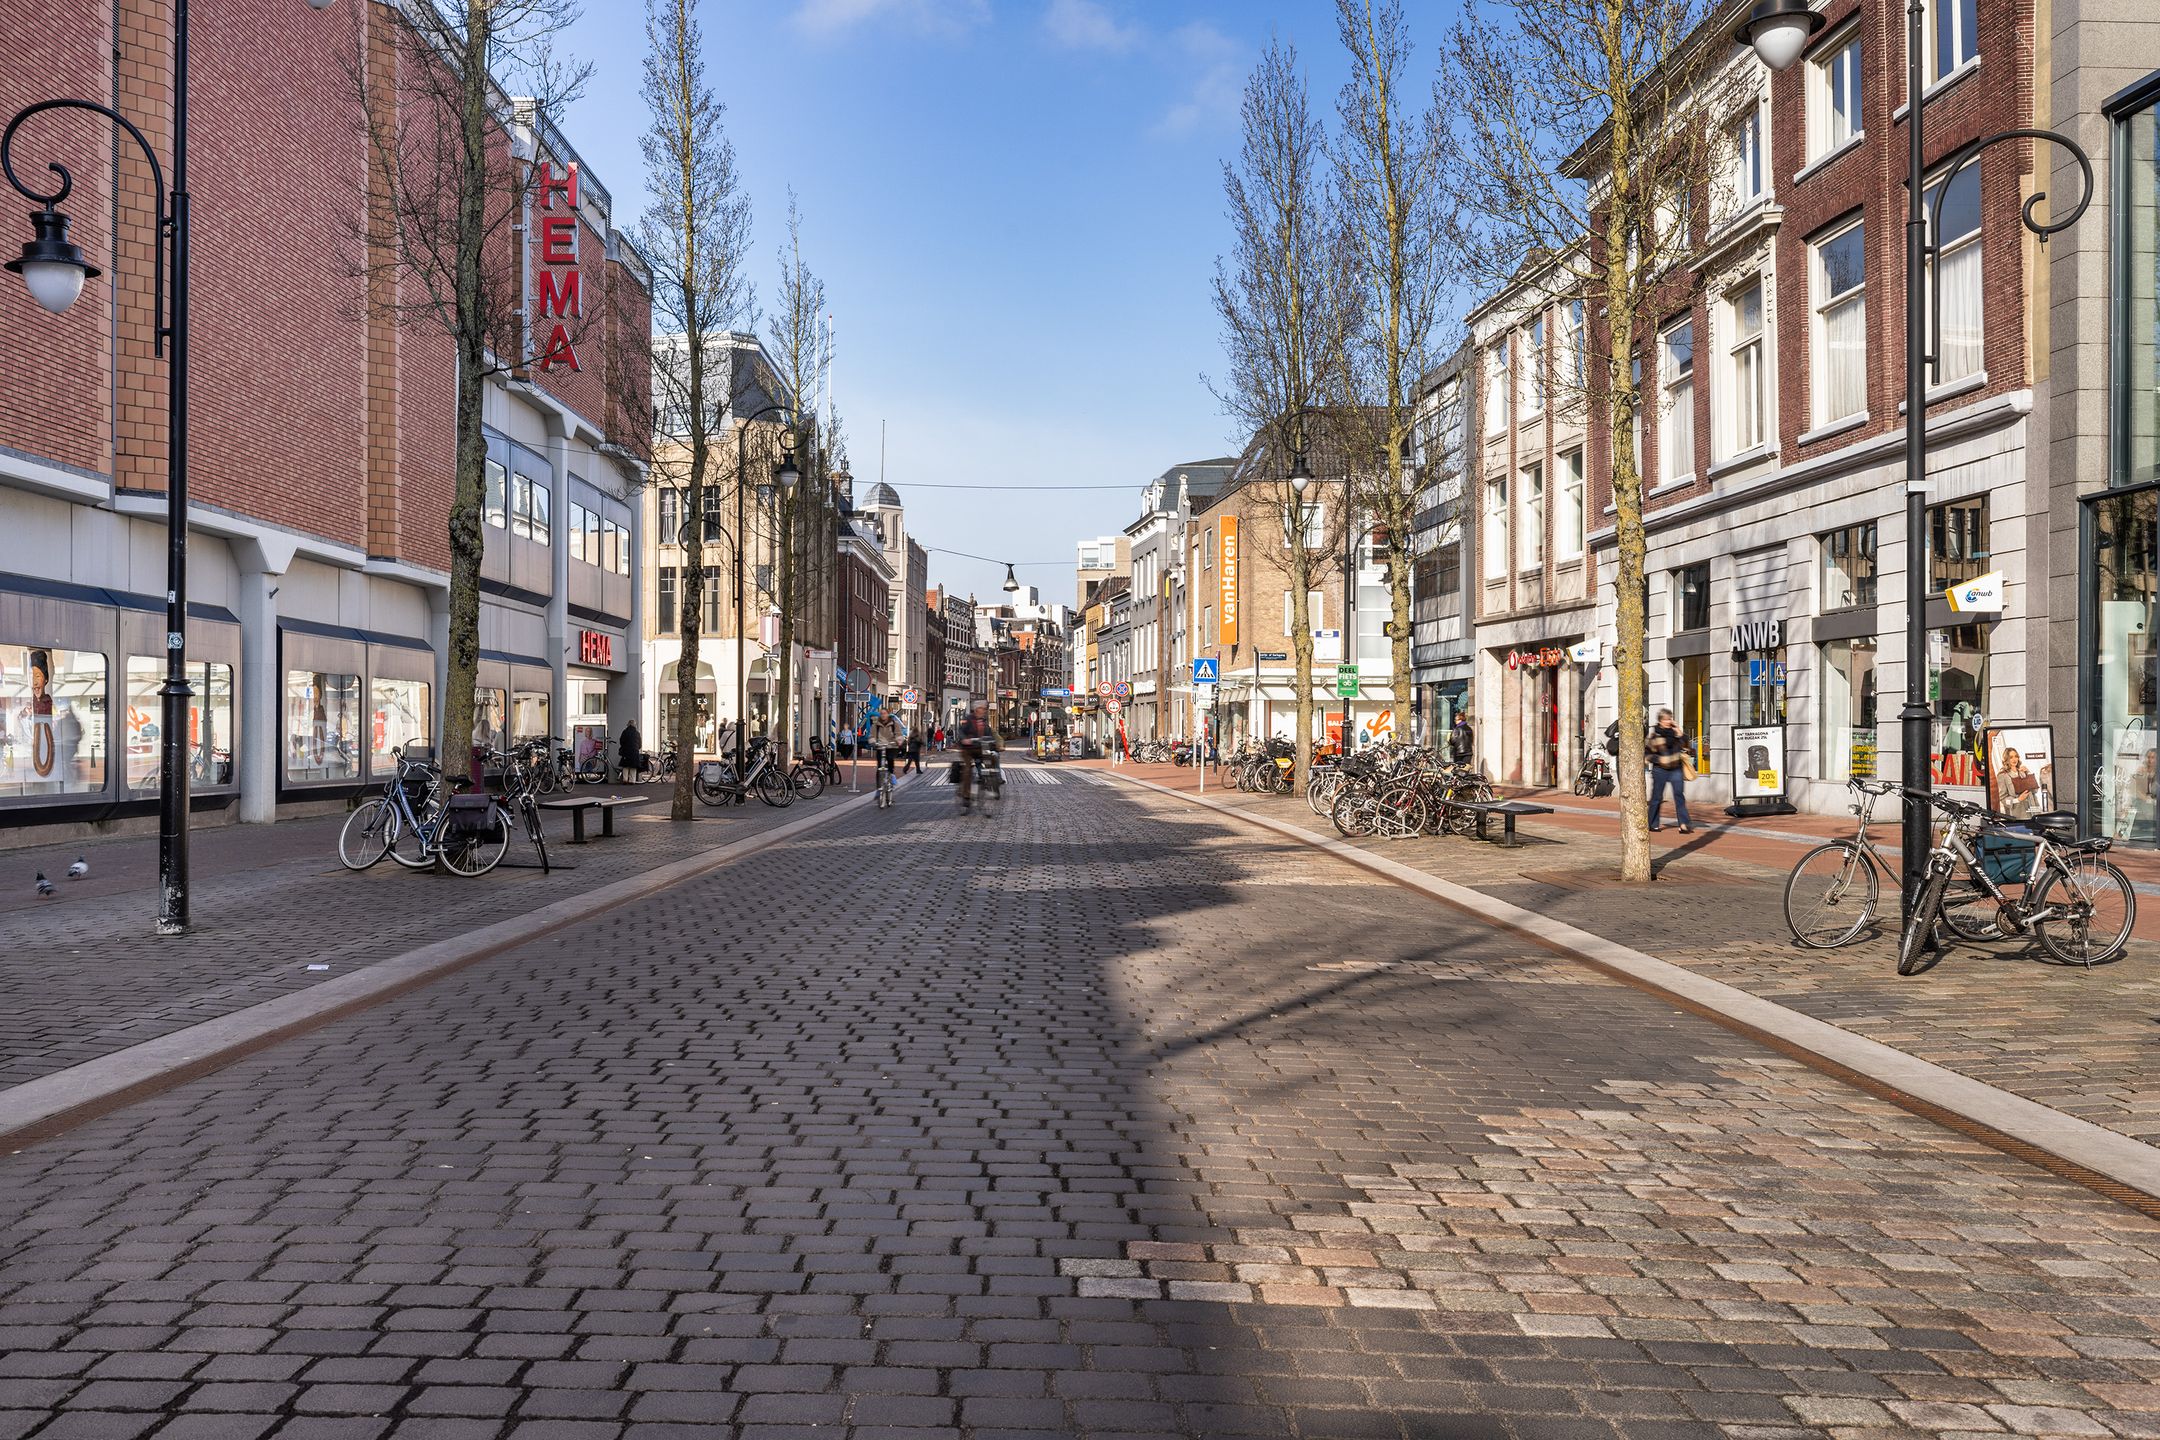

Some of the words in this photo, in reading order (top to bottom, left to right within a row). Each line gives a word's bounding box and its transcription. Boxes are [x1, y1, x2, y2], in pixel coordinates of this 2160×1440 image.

[540, 161, 583, 373] HEMA
[1222, 535, 1235, 624] vanHaren
[580, 630, 612, 666] HEMA
[1730, 620, 1780, 652] ANWB
